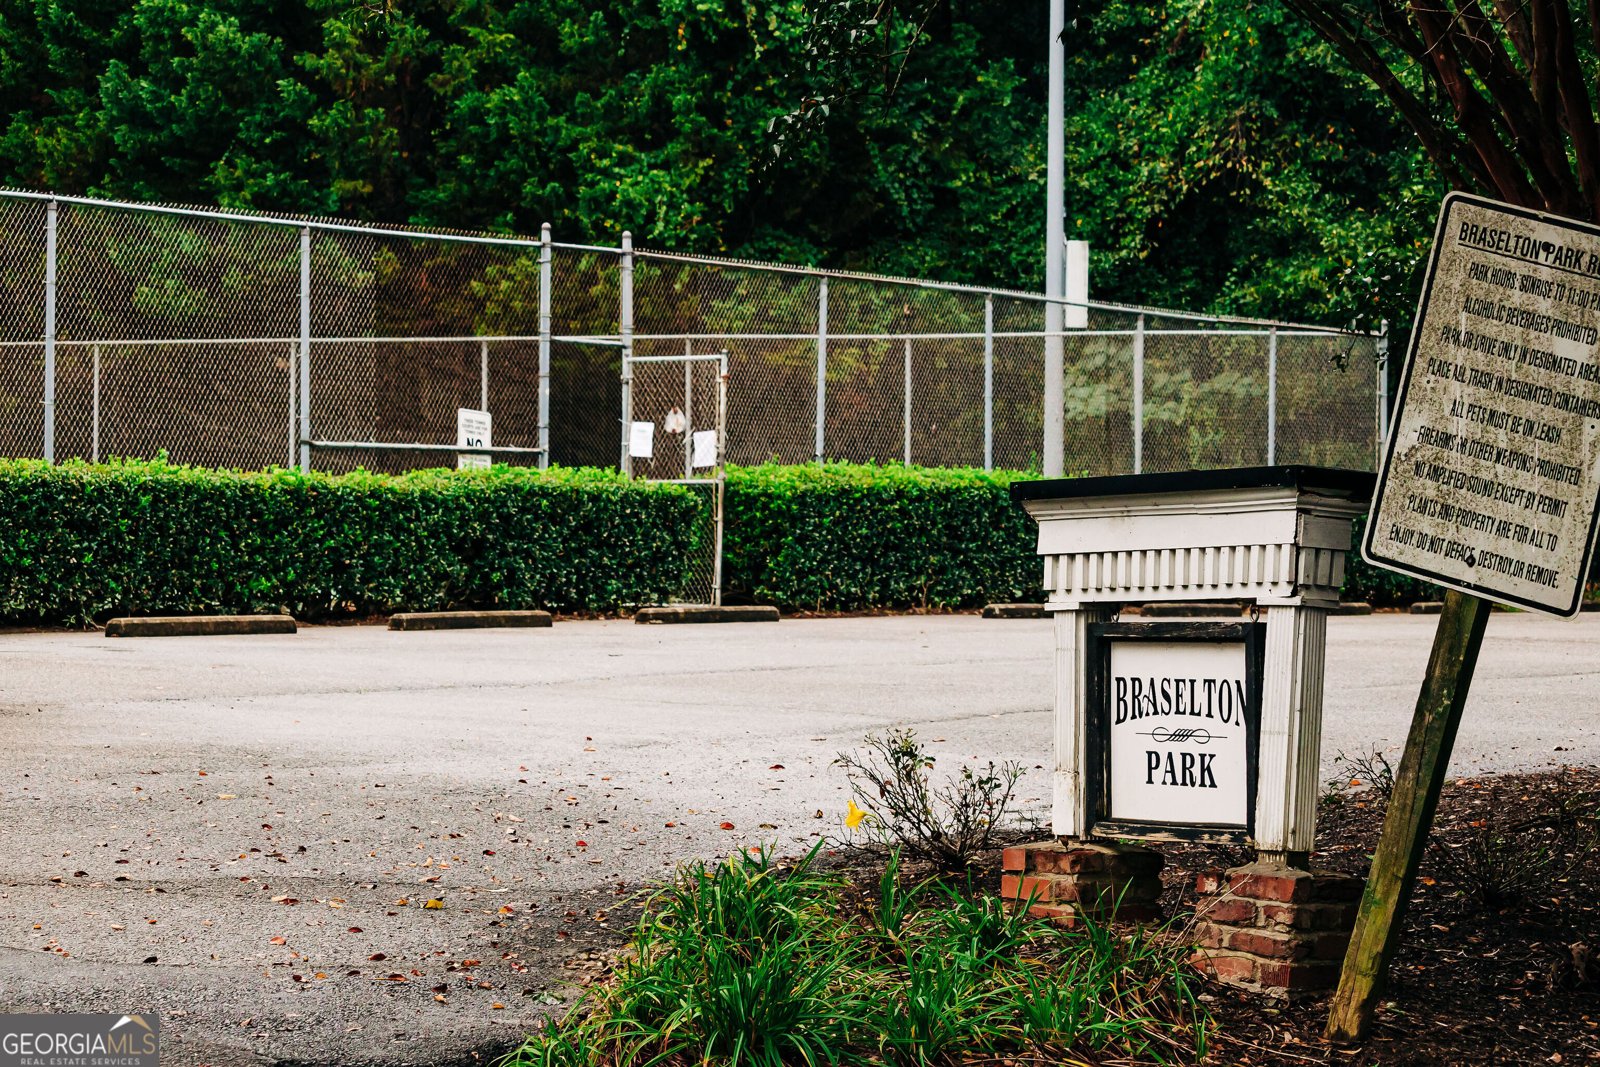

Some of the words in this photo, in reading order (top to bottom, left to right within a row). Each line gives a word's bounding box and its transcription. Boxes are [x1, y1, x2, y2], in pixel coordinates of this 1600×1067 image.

[1459, 222, 1542, 259] BRASELTON
[1546, 243, 1585, 270] PARK
[1587, 254, 1600, 275] R
[1469, 262, 1490, 281] PARK
[1519, 274, 1554, 298] SUNRISE
[1554, 283, 1566, 301] TO
[1567, 287, 1590, 308] 11:00
[1463, 297, 1505, 321] ALCOHOLIC
[1505, 307, 1550, 333] BEVERAGES
[1550, 319, 1598, 346] PROHIBITED
[1441, 326, 1462, 347] PARK
[1462, 331, 1474, 349] OR
[1473, 335, 1498, 355] DRIVE
[1498, 341, 1519, 360] ONLY
[1518, 346, 1528, 364] IN
[1528, 349, 1577, 376] DESIGNATED
[1427, 357, 1452, 379] PLACE
[1452, 364, 1466, 383] ALL
[1467, 368, 1494, 390] TRASH
[1494, 376, 1504, 393] IN
[1504, 378, 1552, 405] DESIGNATED
[1450, 400, 1464, 418] ALL
[1466, 404, 1487, 424] PETS
[1486, 409, 1512, 430] MUST
[1510, 416, 1523, 434] BE
[1523, 419, 1535, 437] ON
[1535, 422, 1561, 444] LEASH
[1417, 426, 1458, 451] FIREARMS
[1457, 436, 1468, 454] OR
[1468, 440, 1494, 461] OTHER
[1495, 447, 1534, 473] WEAPONS
[1533, 458, 1582, 486] PROHIBITED
[1414, 460, 1425, 478] NO
[1425, 463, 1467, 489] AMPLIFIED
[1467, 475, 1494, 497] SOUND
[1494, 482, 1525, 506] EXCEPT
[1524, 491, 1537, 510] BY
[1536, 494, 1568, 518] PERMIT
[1389, 523, 1415, 546] ENJOY.
[1416, 530, 1428, 550] DO
[1428, 535, 1446, 555] NOT
[1407, 494, 1438, 517] PLANTS
[1437, 503, 1455, 522] AND
[1455, 507, 1496, 534] PROPERTY
[1495, 520, 1513, 539] ARE
[1512, 524, 1529, 543] FOR
[1529, 529, 1544, 548] ALL
[1546, 533, 1558, 551] TO
[1115, 676, 1246, 727] BRASELTON
[1146, 750, 1217, 788] PARK
